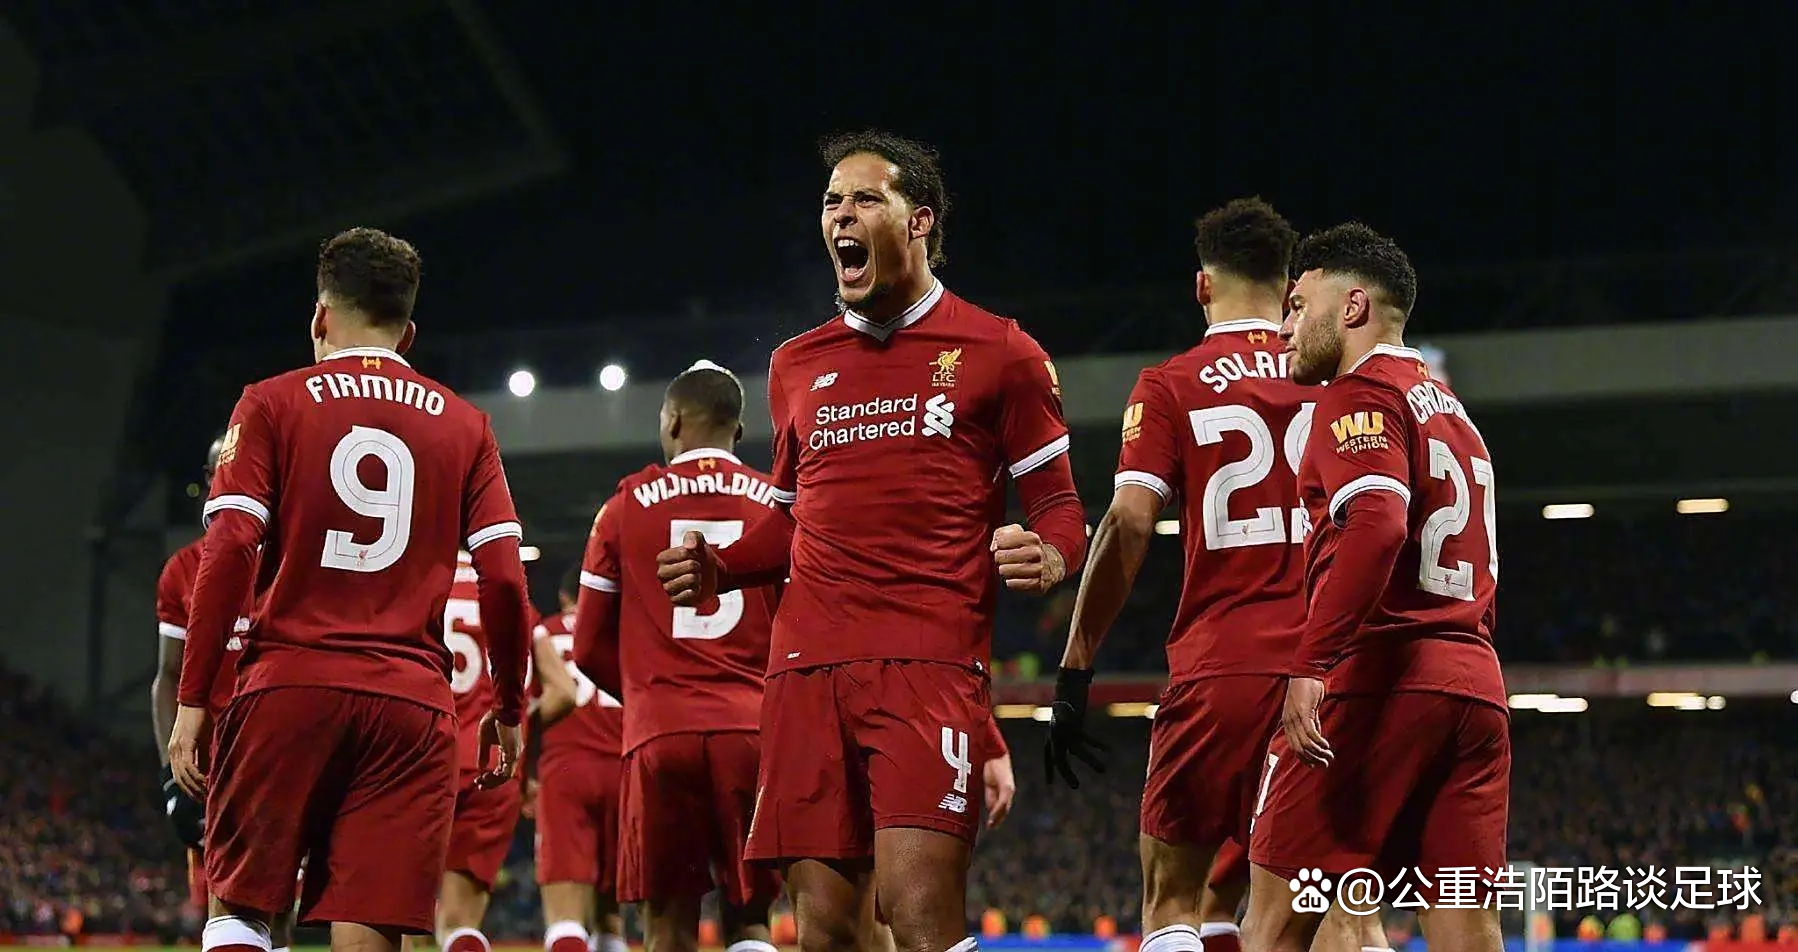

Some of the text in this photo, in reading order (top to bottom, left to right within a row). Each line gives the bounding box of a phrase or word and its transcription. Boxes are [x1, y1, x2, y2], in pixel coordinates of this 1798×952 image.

[306, 373, 445, 416] FIRMINO
[815, 393, 917, 425] Standard
[808, 416, 916, 450] Chartered
[1330, 411, 1384, 444] WU
[1336, 435, 1387, 454] WESTERN
[1351, 442, 1389, 454] UNION
[320, 425, 415, 573] 9
[941, 726, 972, 793] 4
